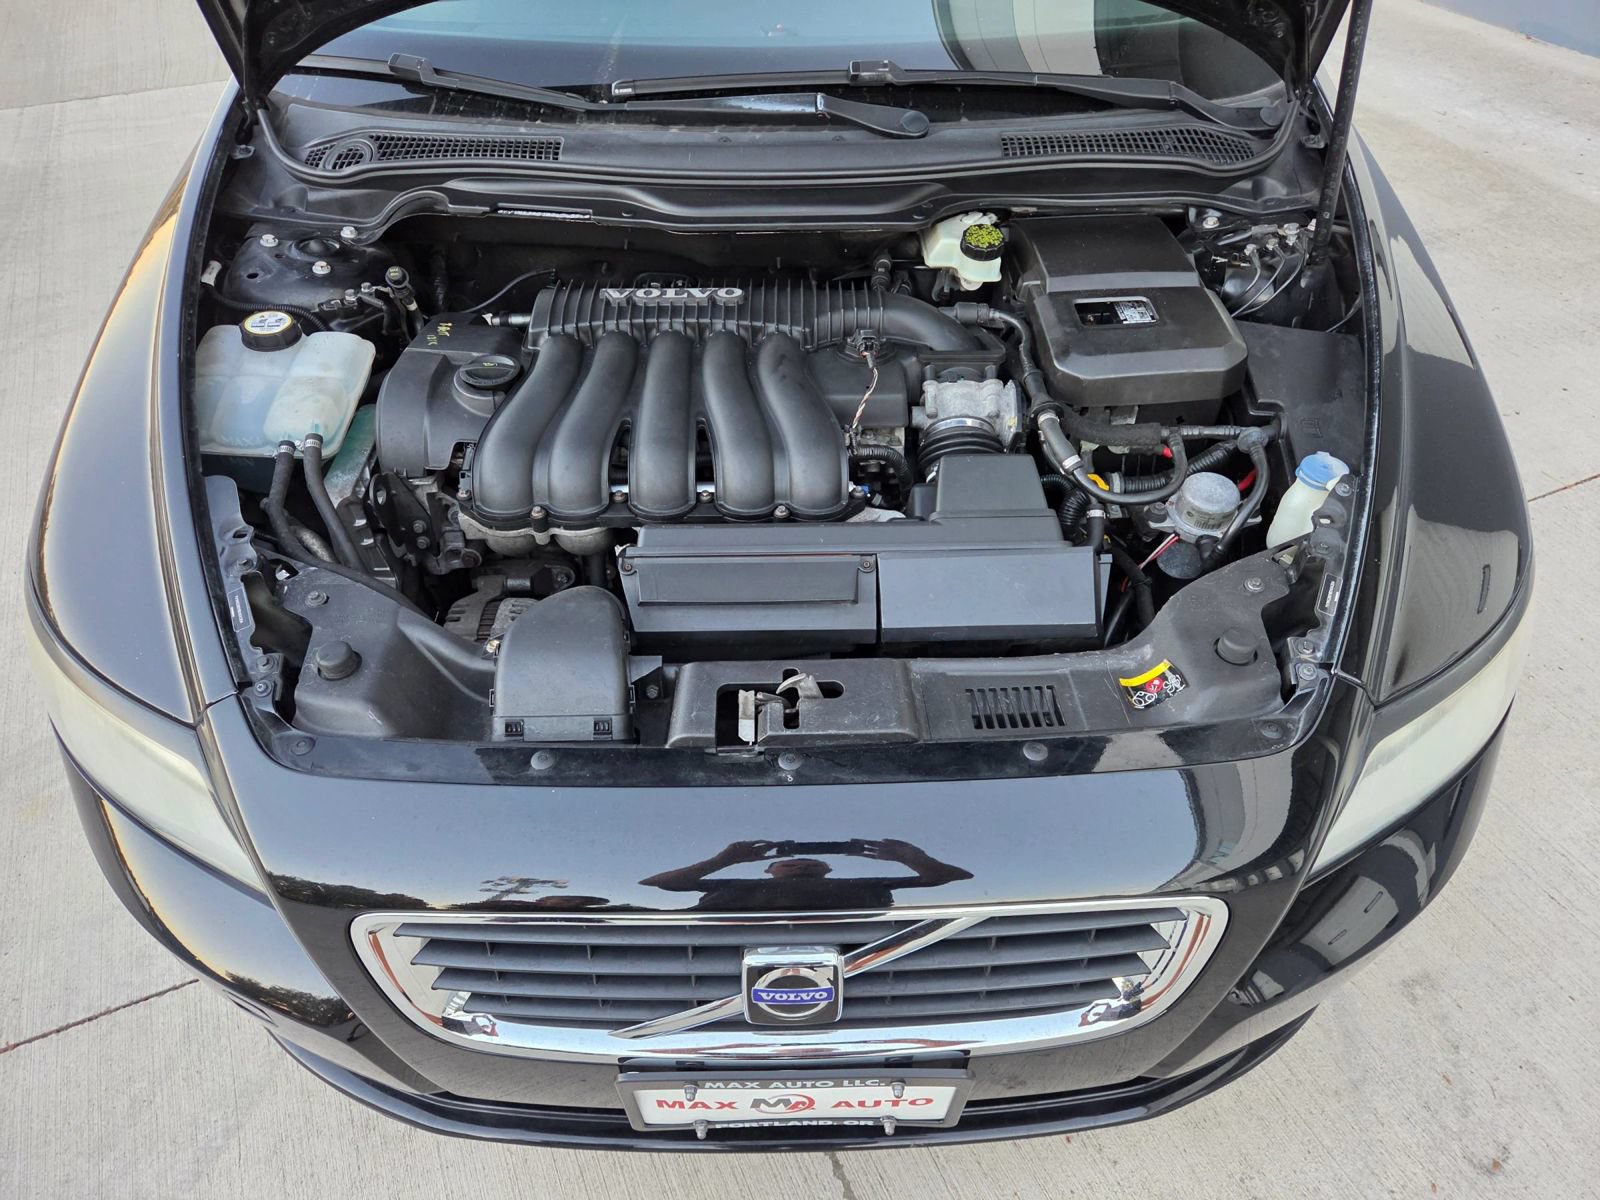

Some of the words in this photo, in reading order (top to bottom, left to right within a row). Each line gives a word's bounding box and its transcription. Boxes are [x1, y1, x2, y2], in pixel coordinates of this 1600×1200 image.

[600, 287, 744, 305] VOLVO
[757, 991, 828, 1001] VOLVO
[704, 1081, 761, 1089] MAX
[768, 1080, 834, 1089] AUTO
[842, 1079, 886, 1087] LLC.
[655, 1099, 738, 1110] MAX
[831, 1097, 934, 1109] AUTO
